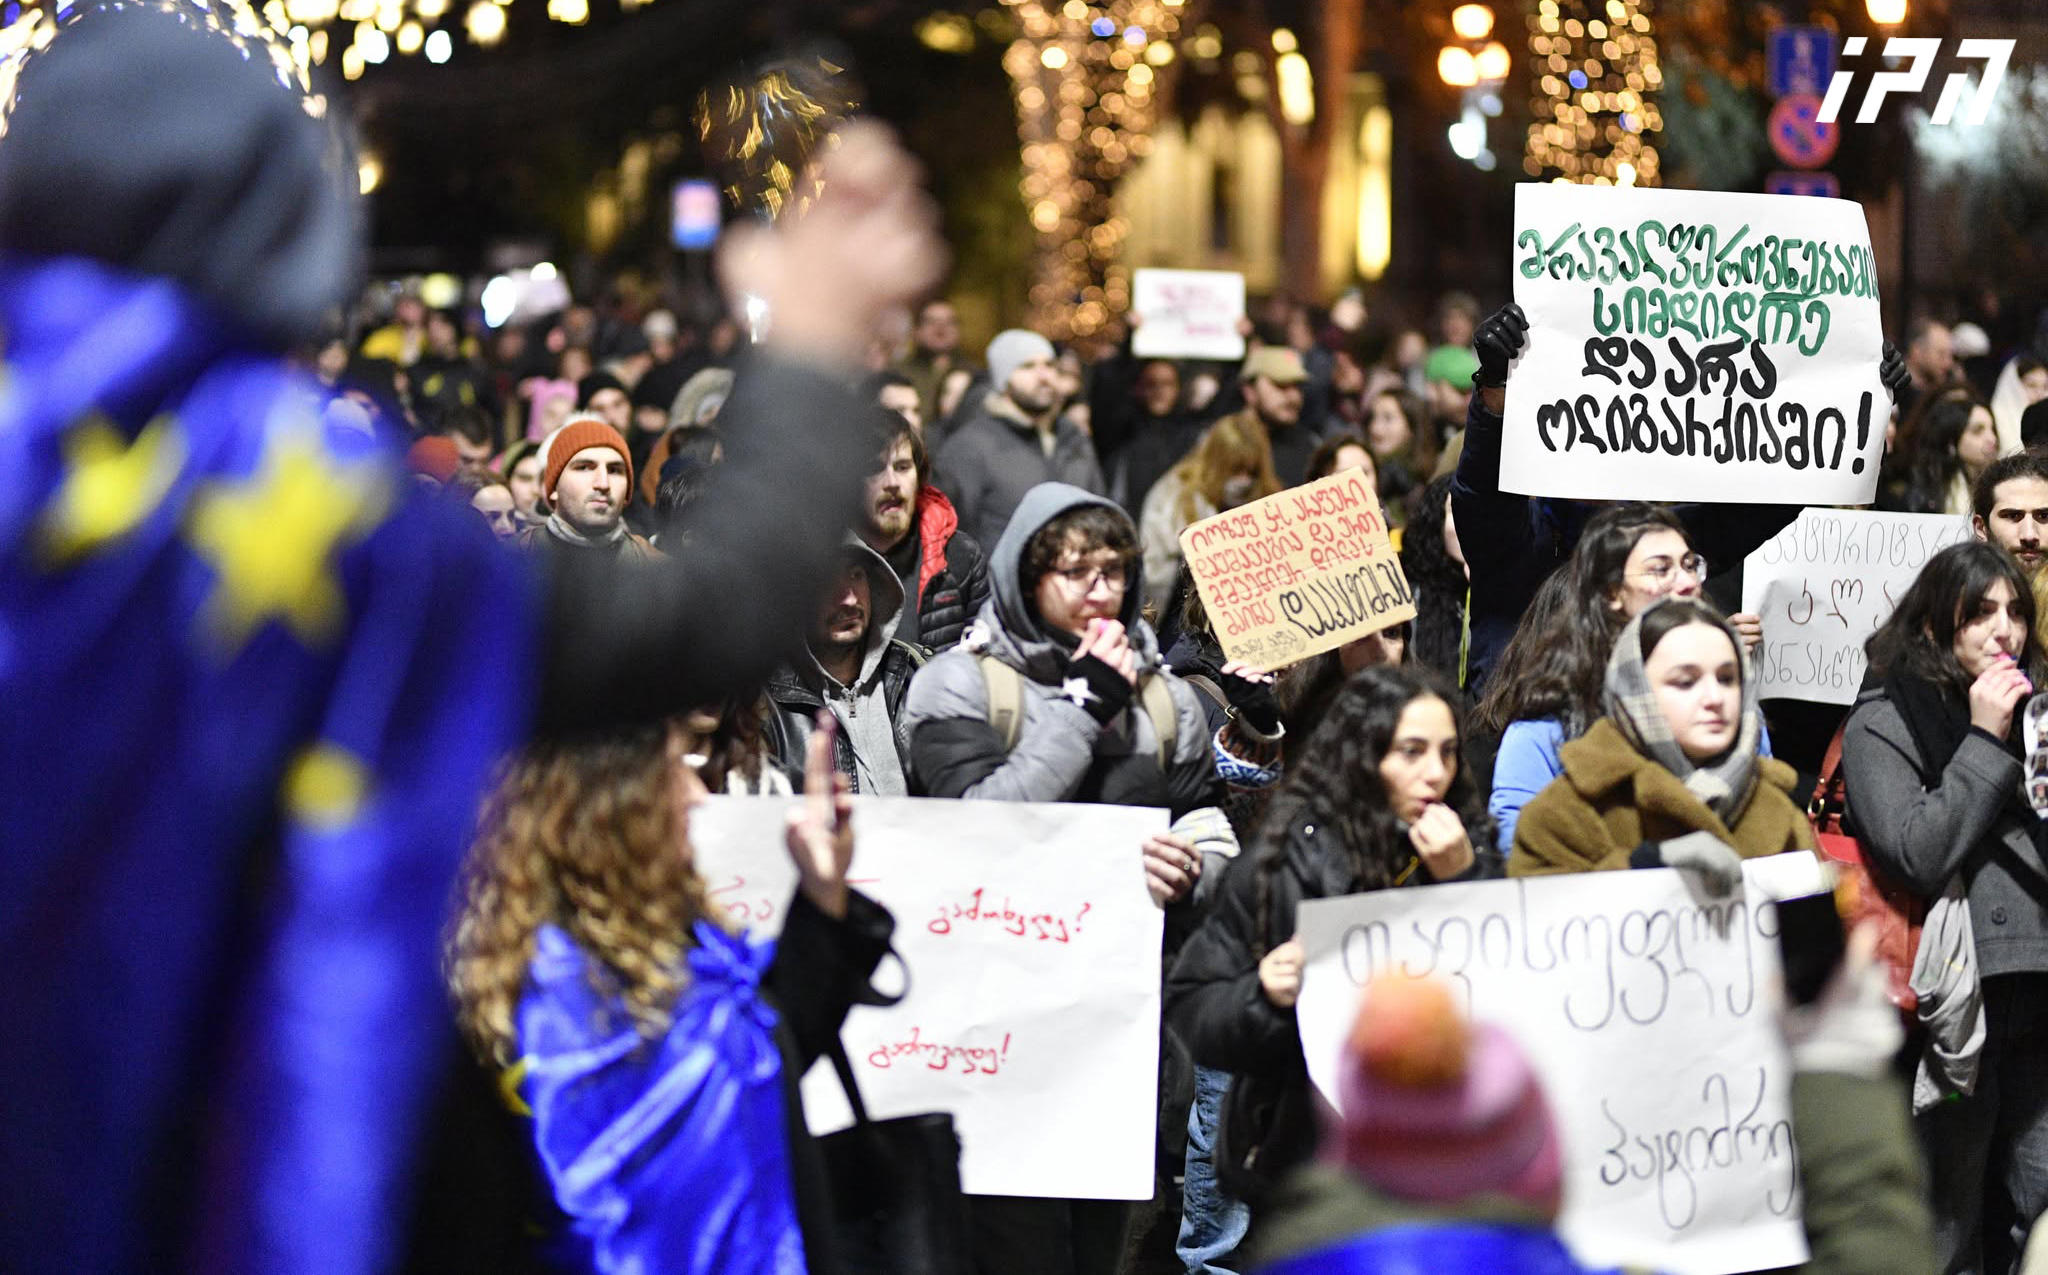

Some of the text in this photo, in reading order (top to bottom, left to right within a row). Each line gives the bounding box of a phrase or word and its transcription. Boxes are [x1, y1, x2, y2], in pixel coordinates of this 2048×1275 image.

[1593, 286, 1831, 356] სიმდიდრე
[1582, 336, 1777, 399] და არა
[1536, 391, 1873, 475] ოლიგარქიაში!
[1191, 513, 1260, 553] იოზეფ
[1292, 478, 1368, 521] არაფერი
[1309, 522, 1334, 544] და
[1338, 511, 1380, 540] ერთ
[1311, 537, 1374, 571] დილას
[1600, 1066, 1796, 1230] პატიმრე
